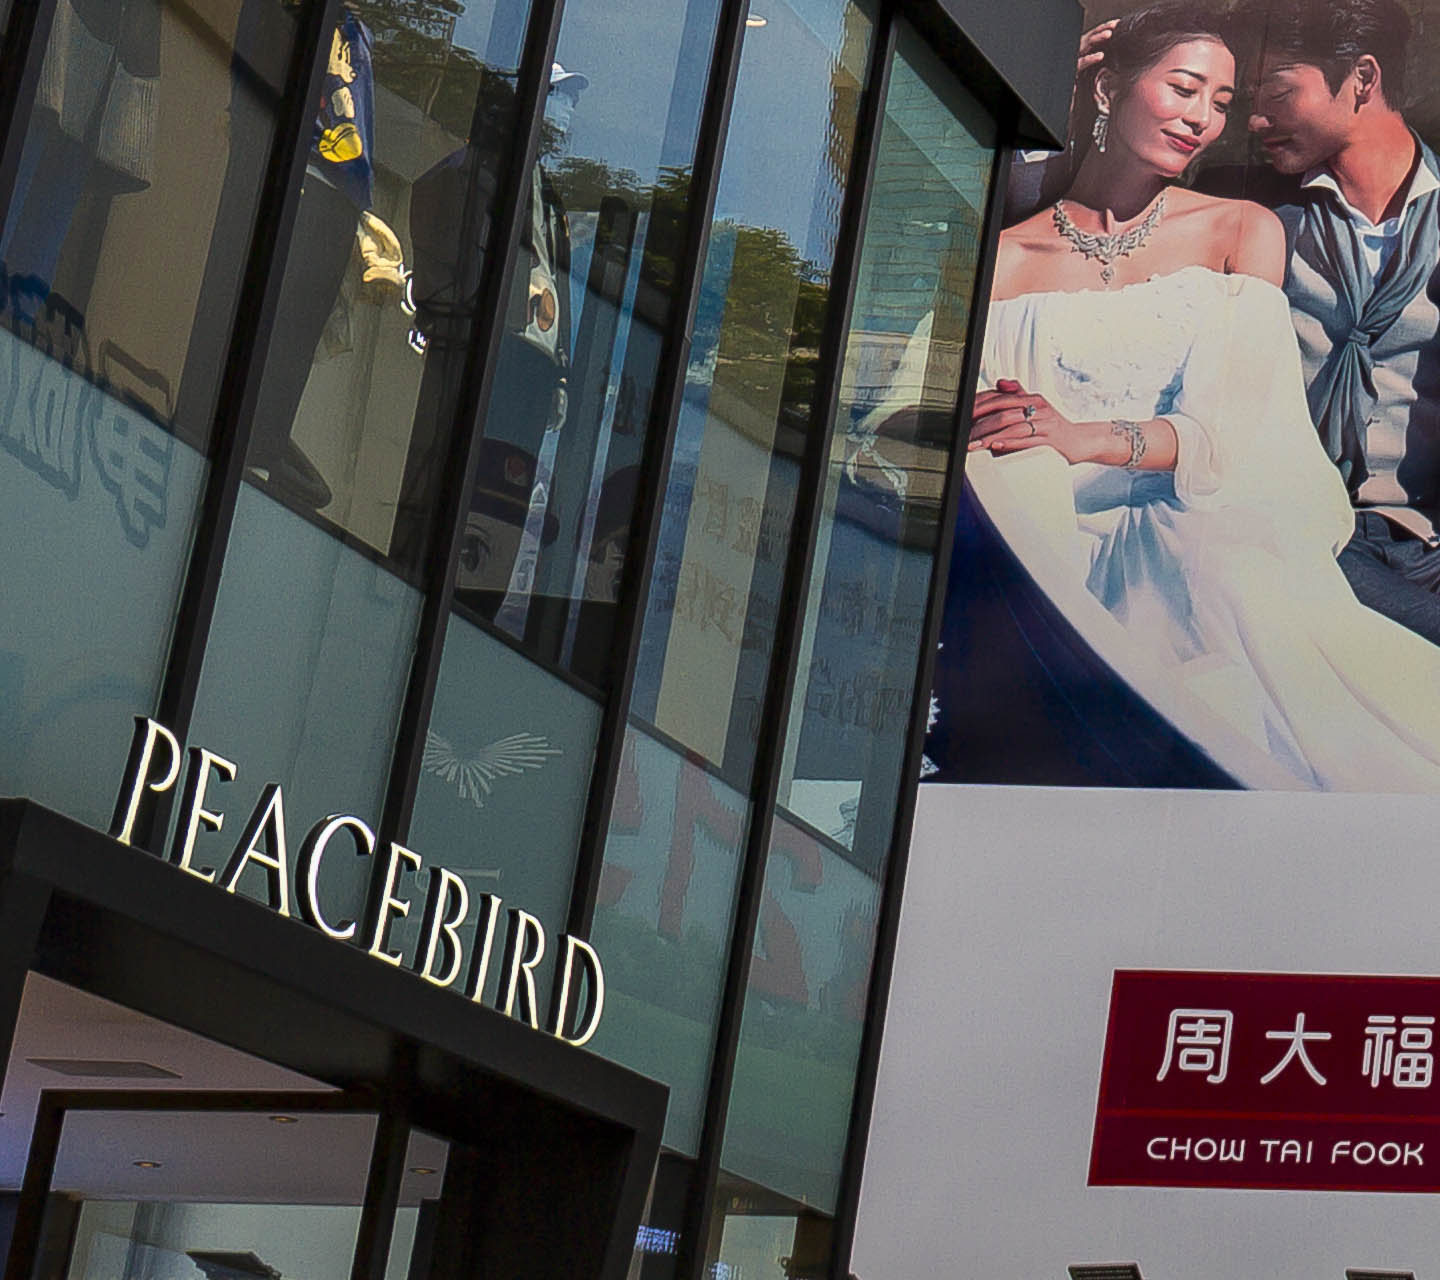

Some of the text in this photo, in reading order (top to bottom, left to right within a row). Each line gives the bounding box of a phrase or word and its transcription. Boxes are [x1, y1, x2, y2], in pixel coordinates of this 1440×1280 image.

[110, 717, 606, 1048] PEACEBIRD
[1157, 1007, 1435, 1090] 周大福
[1146, 1136, 1426, 1168] CHOW TAI FOOK
